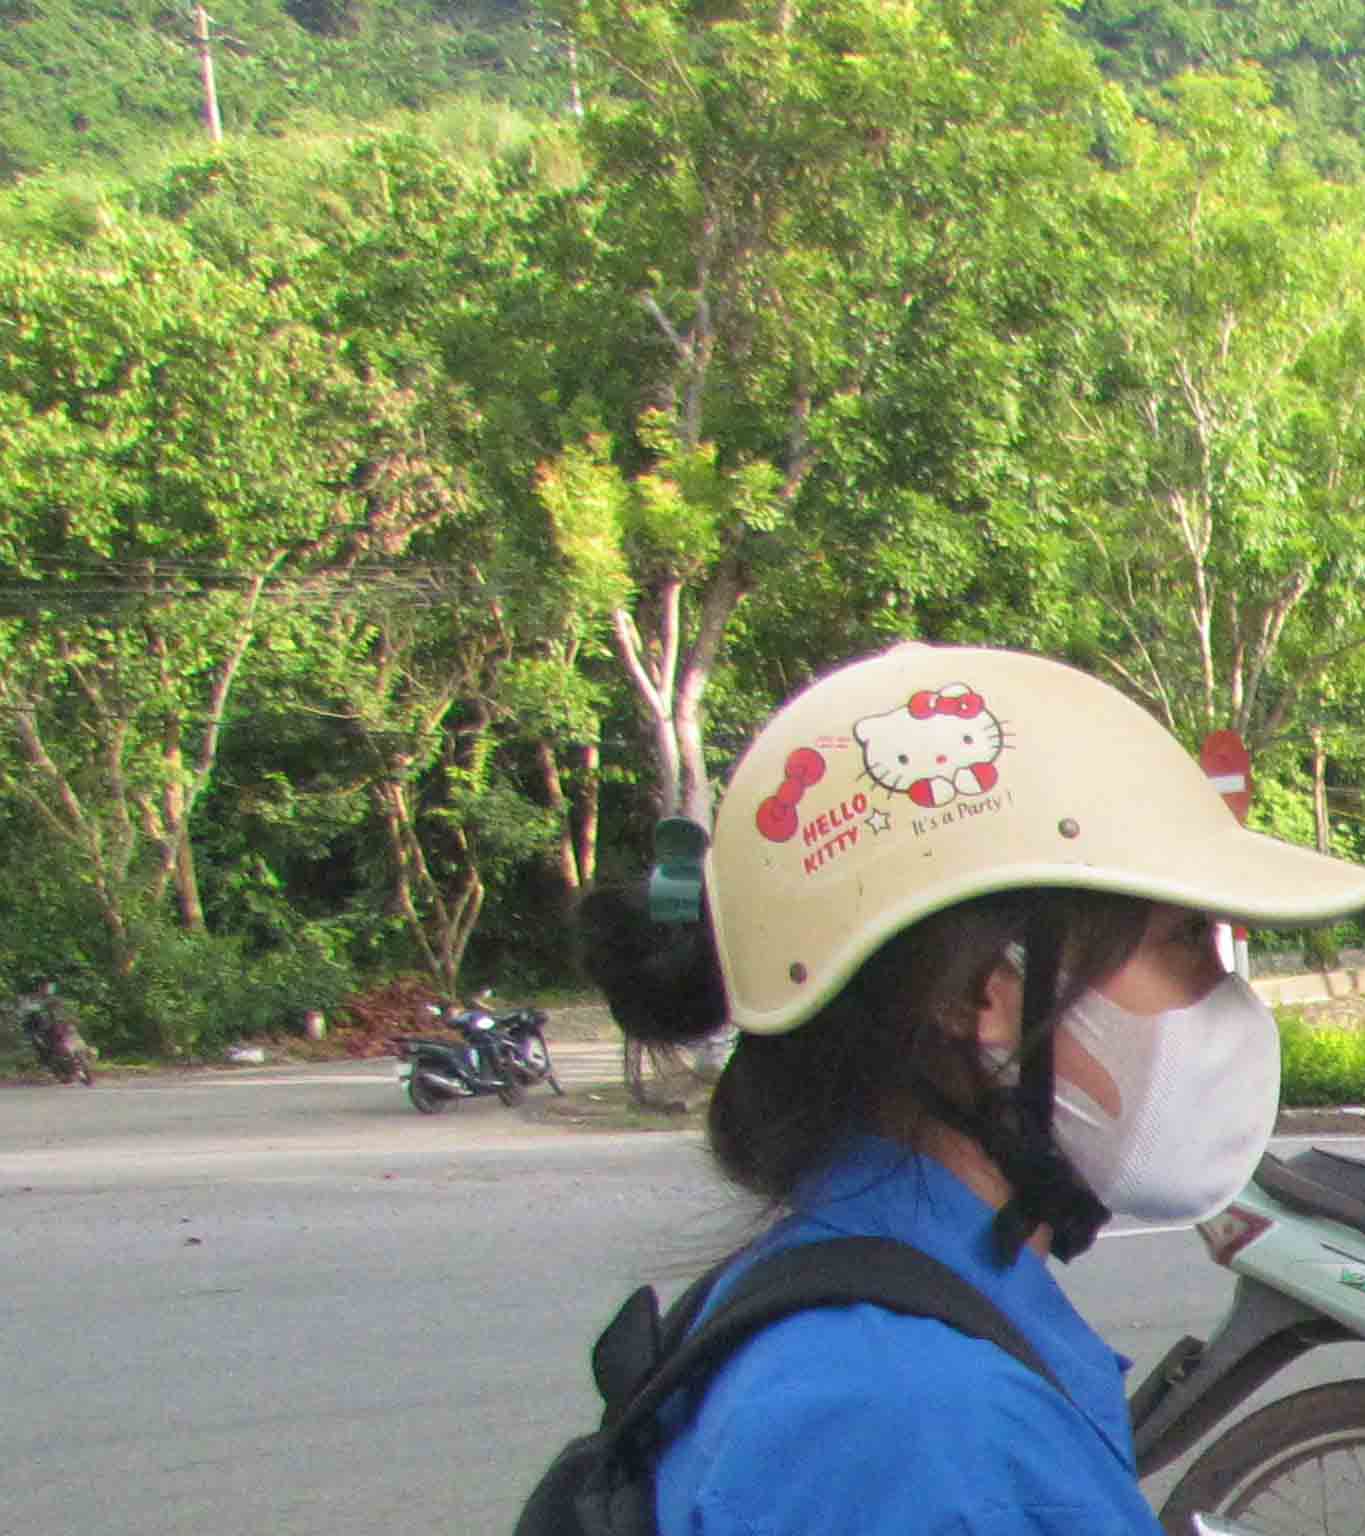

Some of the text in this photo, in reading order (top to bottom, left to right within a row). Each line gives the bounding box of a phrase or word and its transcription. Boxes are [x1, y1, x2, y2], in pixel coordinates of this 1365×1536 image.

[802, 791, 868, 847] HELLO
[911, 813, 938, 836] It's
[956, 796, 1001, 817] Party
[801, 825, 860, 876] KITTY
